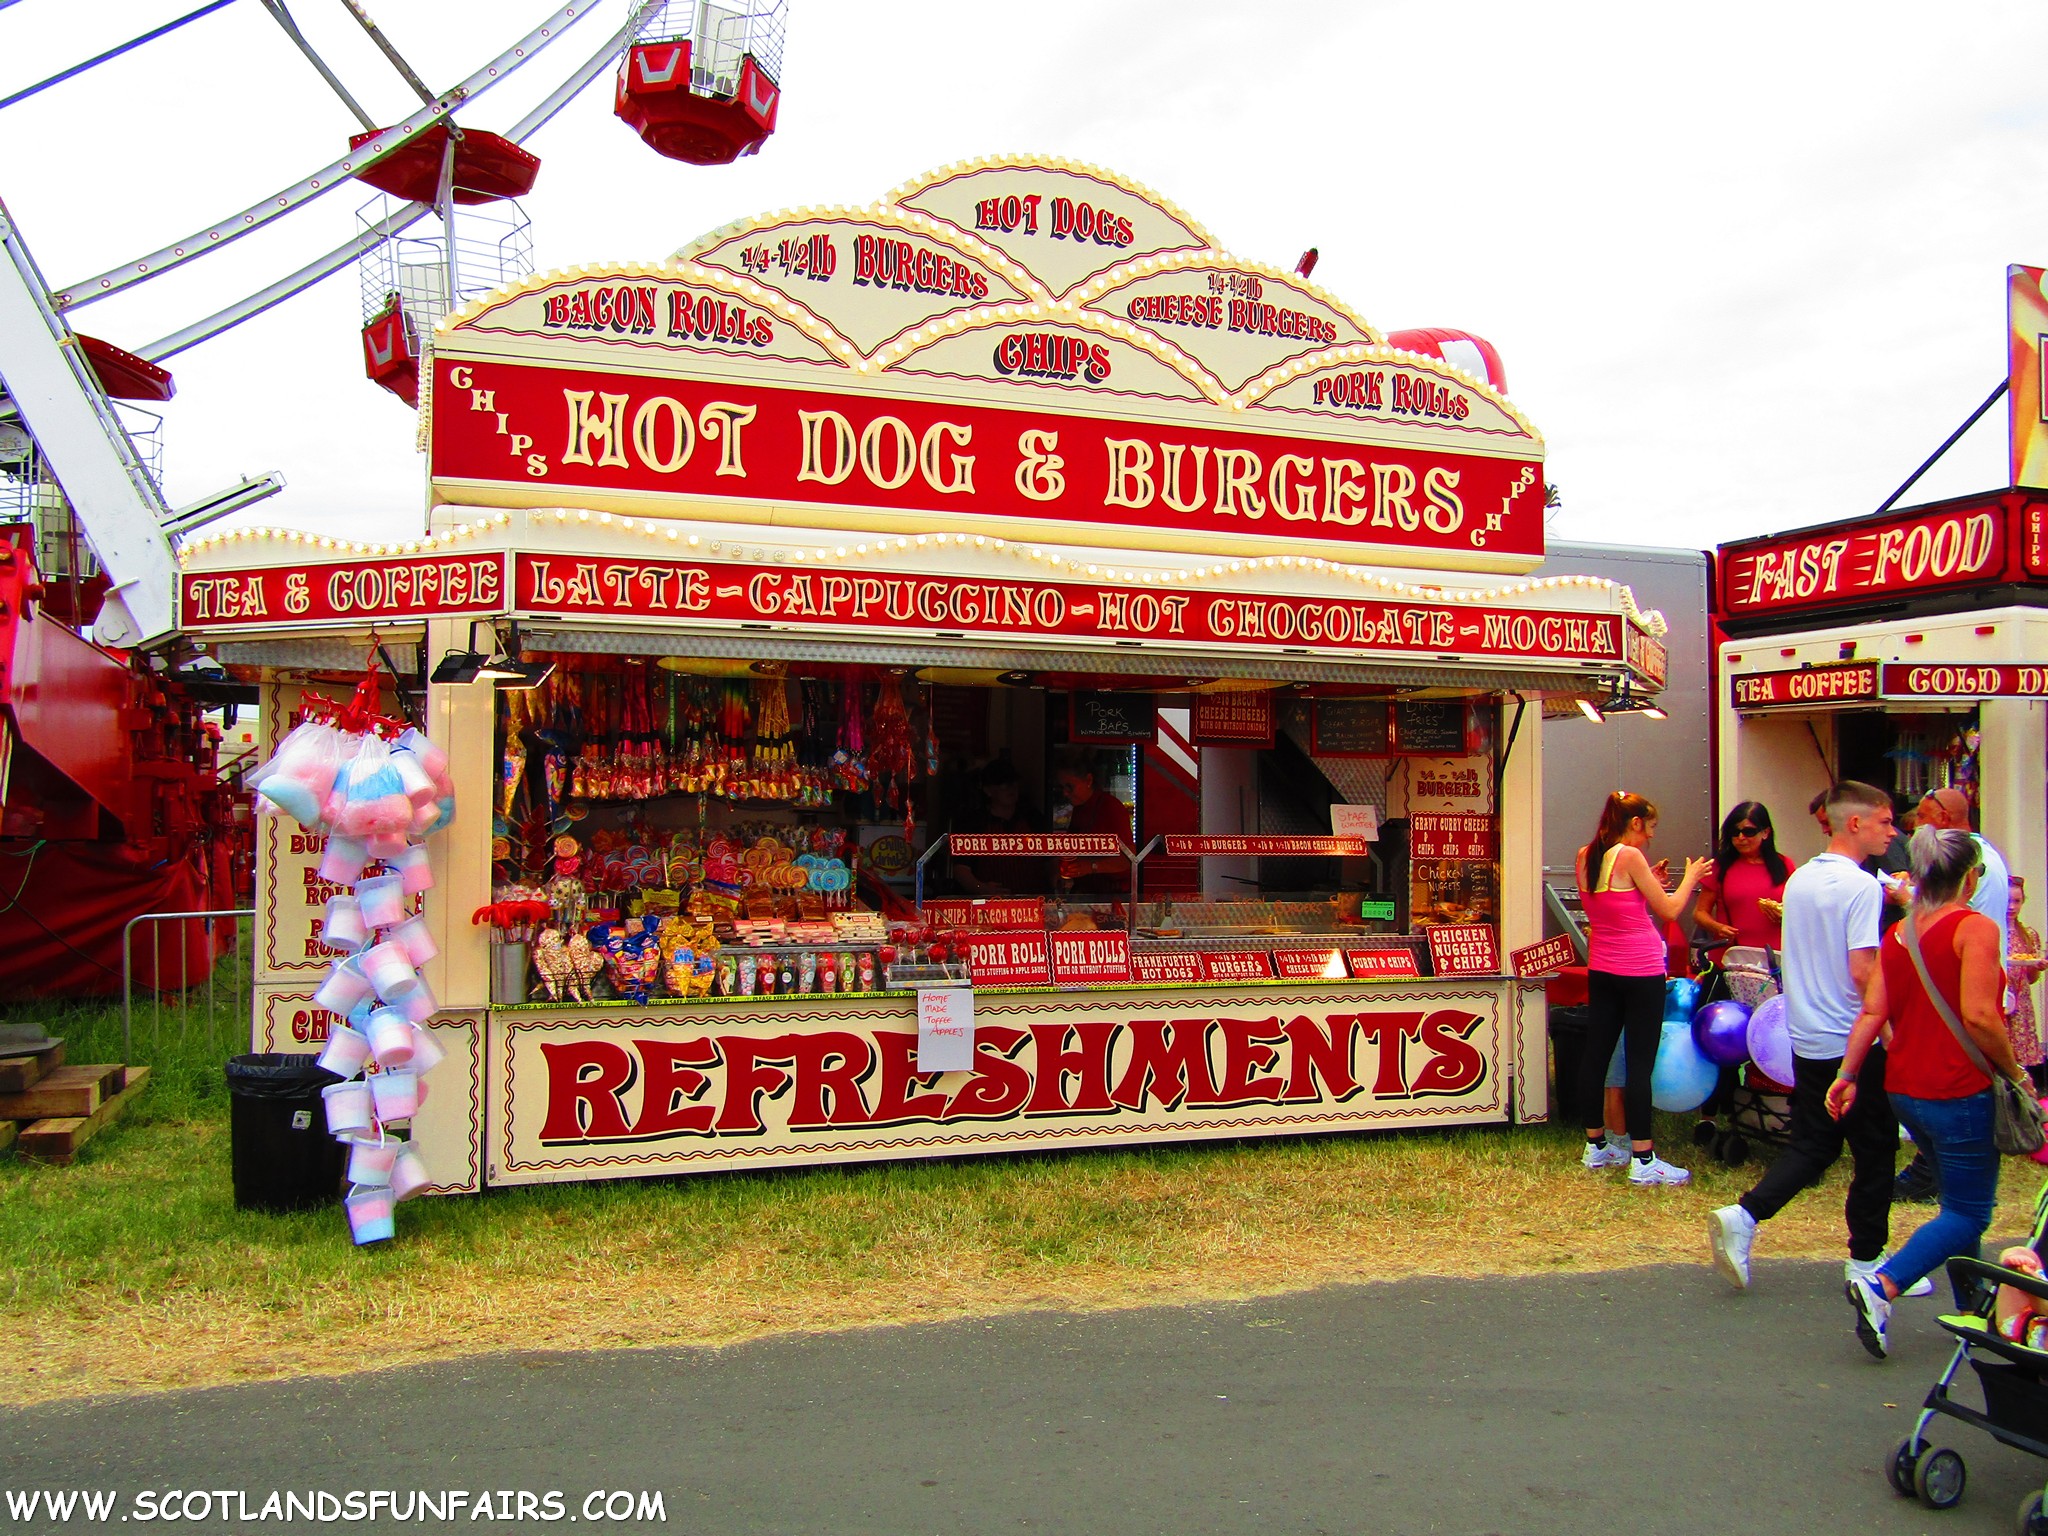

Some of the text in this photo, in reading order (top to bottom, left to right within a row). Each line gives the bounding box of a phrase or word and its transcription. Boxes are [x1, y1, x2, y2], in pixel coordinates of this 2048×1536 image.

[976, 195, 1134, 247] HOT DOGS
[853, 234, 988, 299] BURGERS
[544, 288, 774, 347] BACON ROLLS
[1127, 295, 1338, 344] CHEESE BURGERS
[994, 334, 1111, 384] CHIPS
[1313, 372, 1470, 420] PORK ROLLS
[562, 388, 1464, 535] HOT DOG & BURGERS
[1749, 514, 1994, 603] FAST FOOD
[190, 561, 499, 619] TEA & COFFEE
[1735, 669, 1873, 703] TEA COFFEE
[1908, 667, 2001, 694] COLD
[1231, 691, 1257, 707] BACON
[1086, 701, 1126, 720] PORK
[1200, 706, 1267, 721] CHEESE BURGERS
[1099, 718, 1129, 731] BAPS
[1200, 720, 1214, 730] WITH
[1223, 721, 1246, 730] WITHOUT
[1417, 781, 1481, 797] BURGERS
[1337, 808, 1367, 822] STAFF
[1414, 817, 1489, 831] GRAVY CURRY CHEESE
[956, 837, 1117, 851] PORK BAPS OR BAGUETTES
[1212, 840, 1247, 850] BURGERS
[1291, 840, 1312, 850] BACON
[1313, 840, 1335, 851] CHEESE
[1336, 840, 1362, 851] BURGERS
[1417, 844, 1484, 855] CHIPS CHIPS CHIPS
[977, 907, 1040, 924] BACON ROLLS
[1433, 929, 1488, 943] CHICKEN
[971, 941, 1047, 967] PORK ROLL
[1055, 940, 1127, 965] PORK ROLLS
[1435, 942, 1492, 957] NUGGETS
[1523, 941, 1561, 962] JUMBO
[1133, 954, 1198, 968] FRANKFURTER
[1210, 960, 1263, 974] BURGERS
[1286, 964, 1309, 974] CHEESE
[1353, 955, 1412, 968] CURRY & CHIPS
[1440, 955, 1492, 970] & CHIPS
[1519, 949, 1570, 977] SAUSAGE
[987, 967, 1009, 975] STUFFING
[1015, 967, 1030, 975] APPLE
[1031, 965, 1047, 973] SAUCE
[1057, 965, 1127, 975] WITH OR WITHOUT STUFFING
[1142, 967, 1195, 979] HOT DOGS
[709, 996, 731, 1004] APART
[537, 1011, 1486, 1147] REFRESHMENTS
